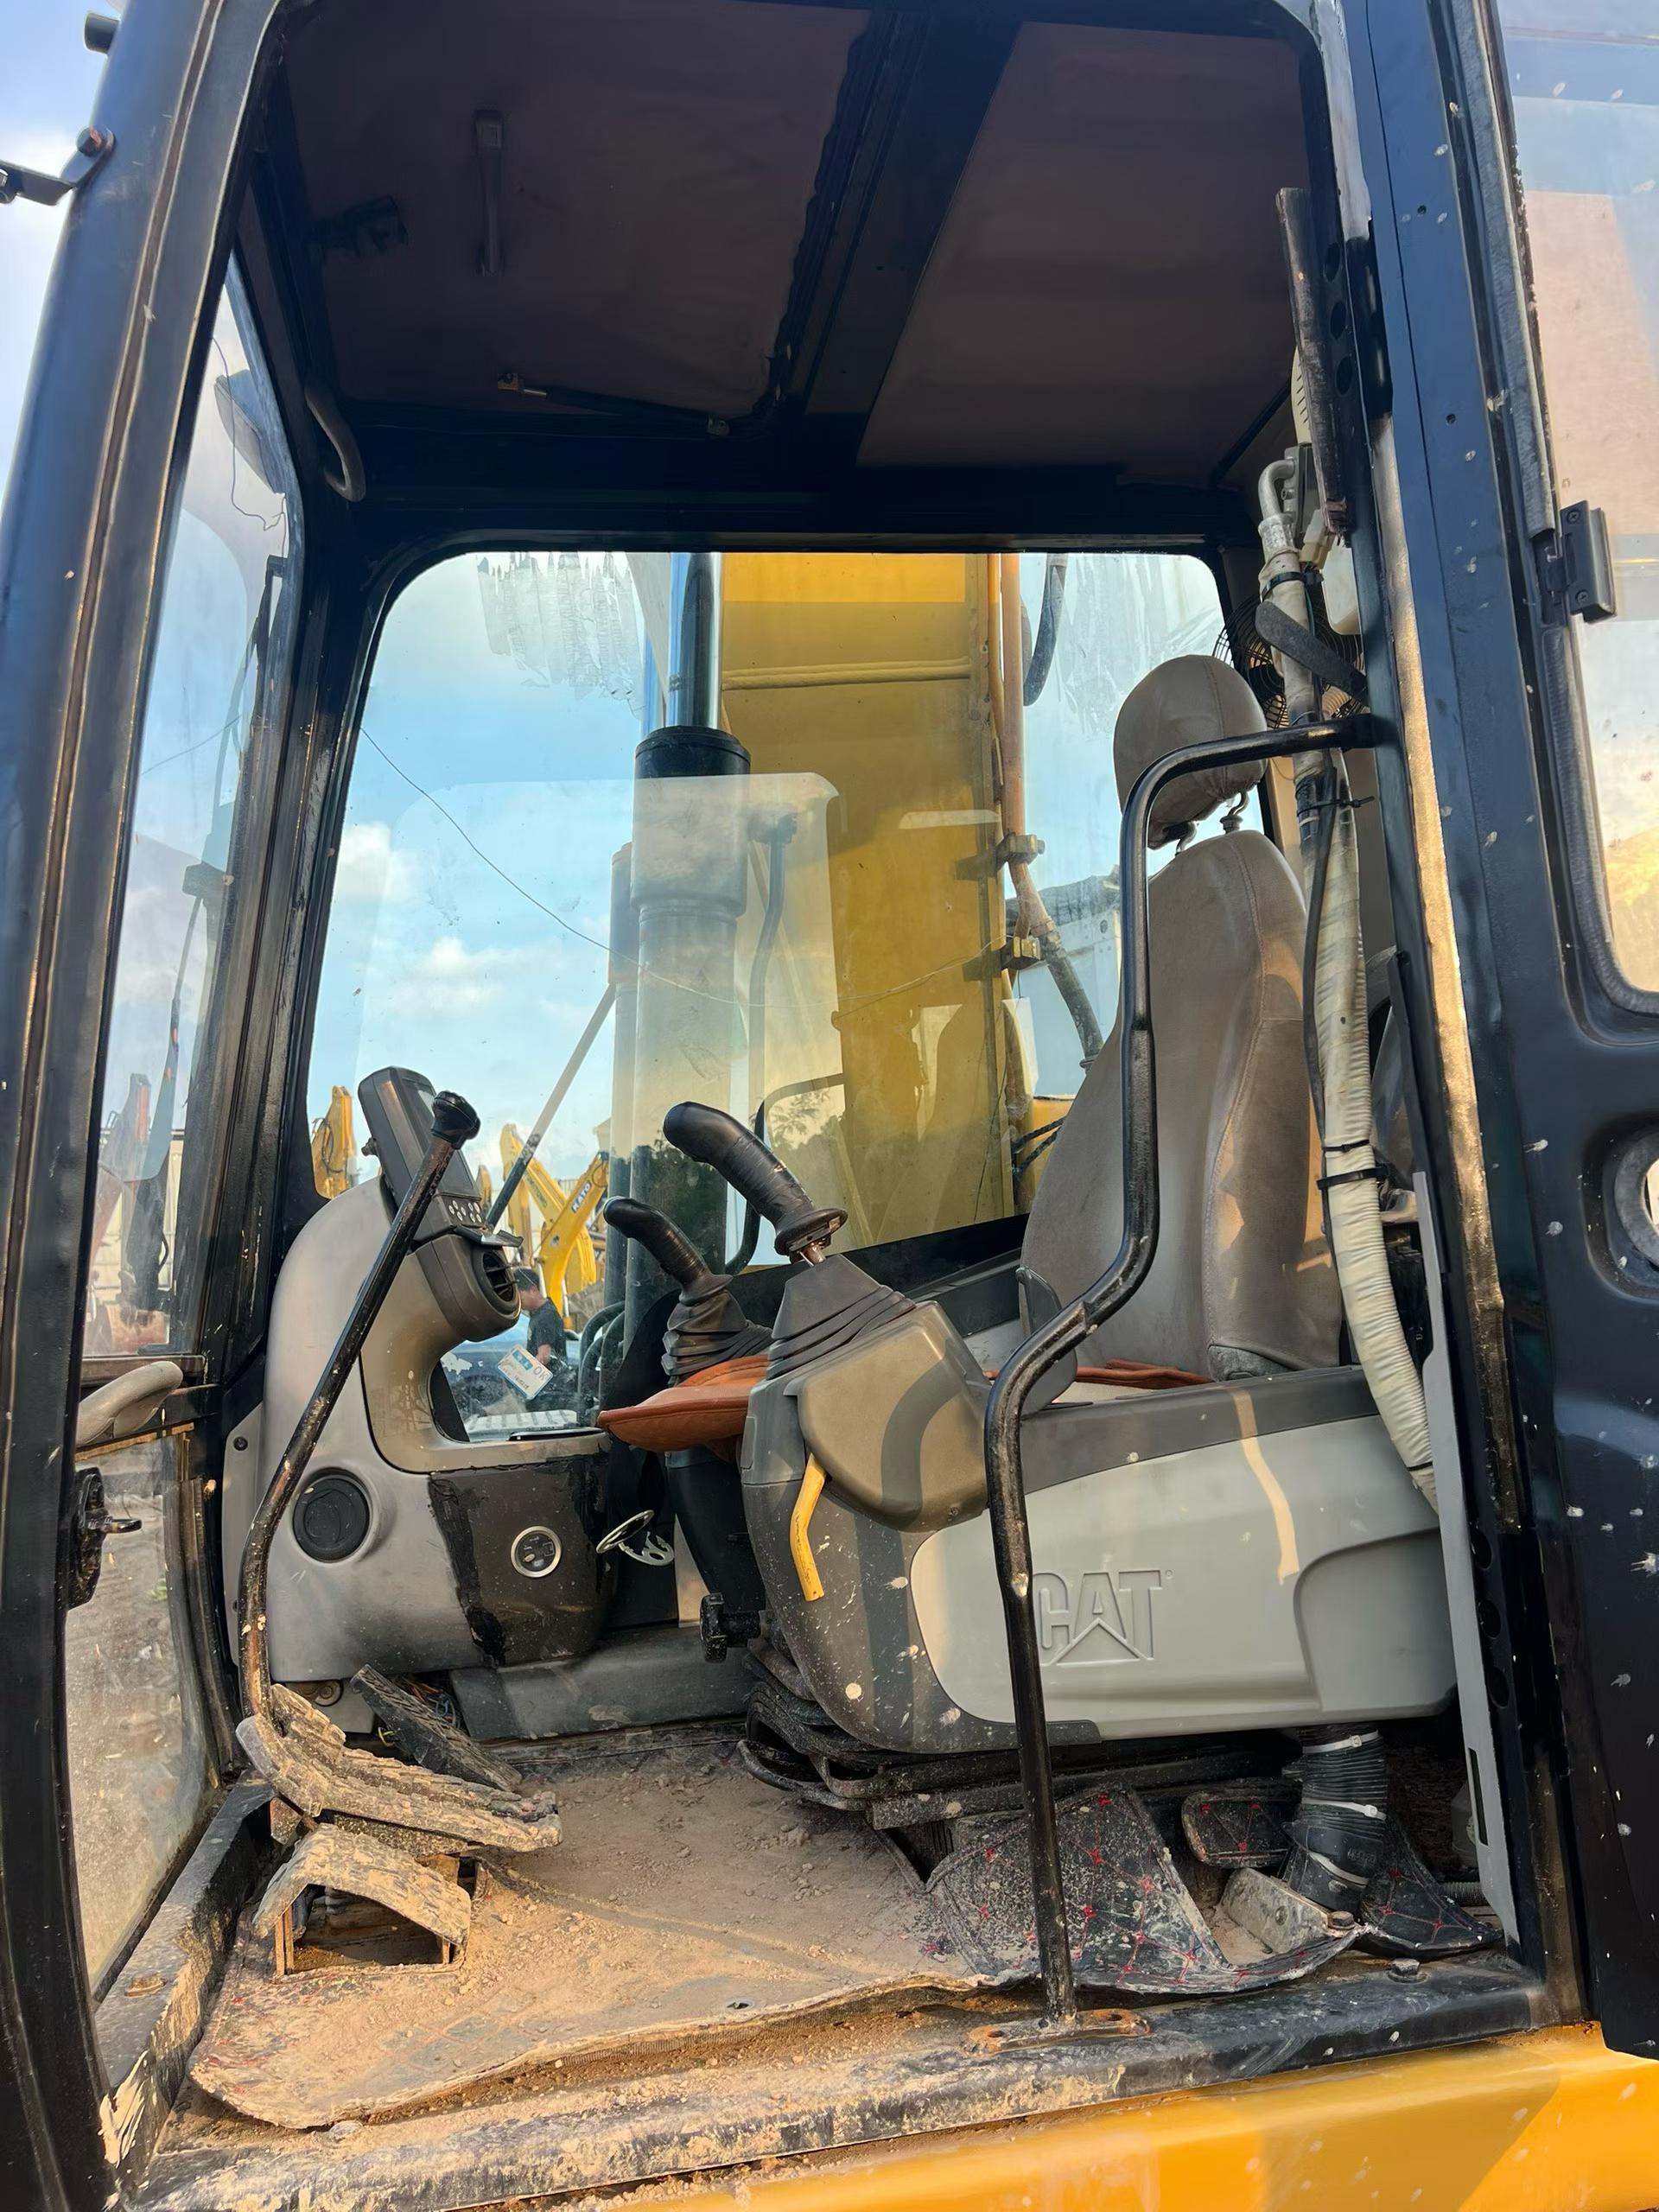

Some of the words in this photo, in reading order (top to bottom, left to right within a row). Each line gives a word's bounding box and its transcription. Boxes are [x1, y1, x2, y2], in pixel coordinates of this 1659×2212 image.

[571, 1181, 592, 1213] KATO
[532, 1365, 549, 1382] OK
[1033, 1569, 1163, 1667] CAT
